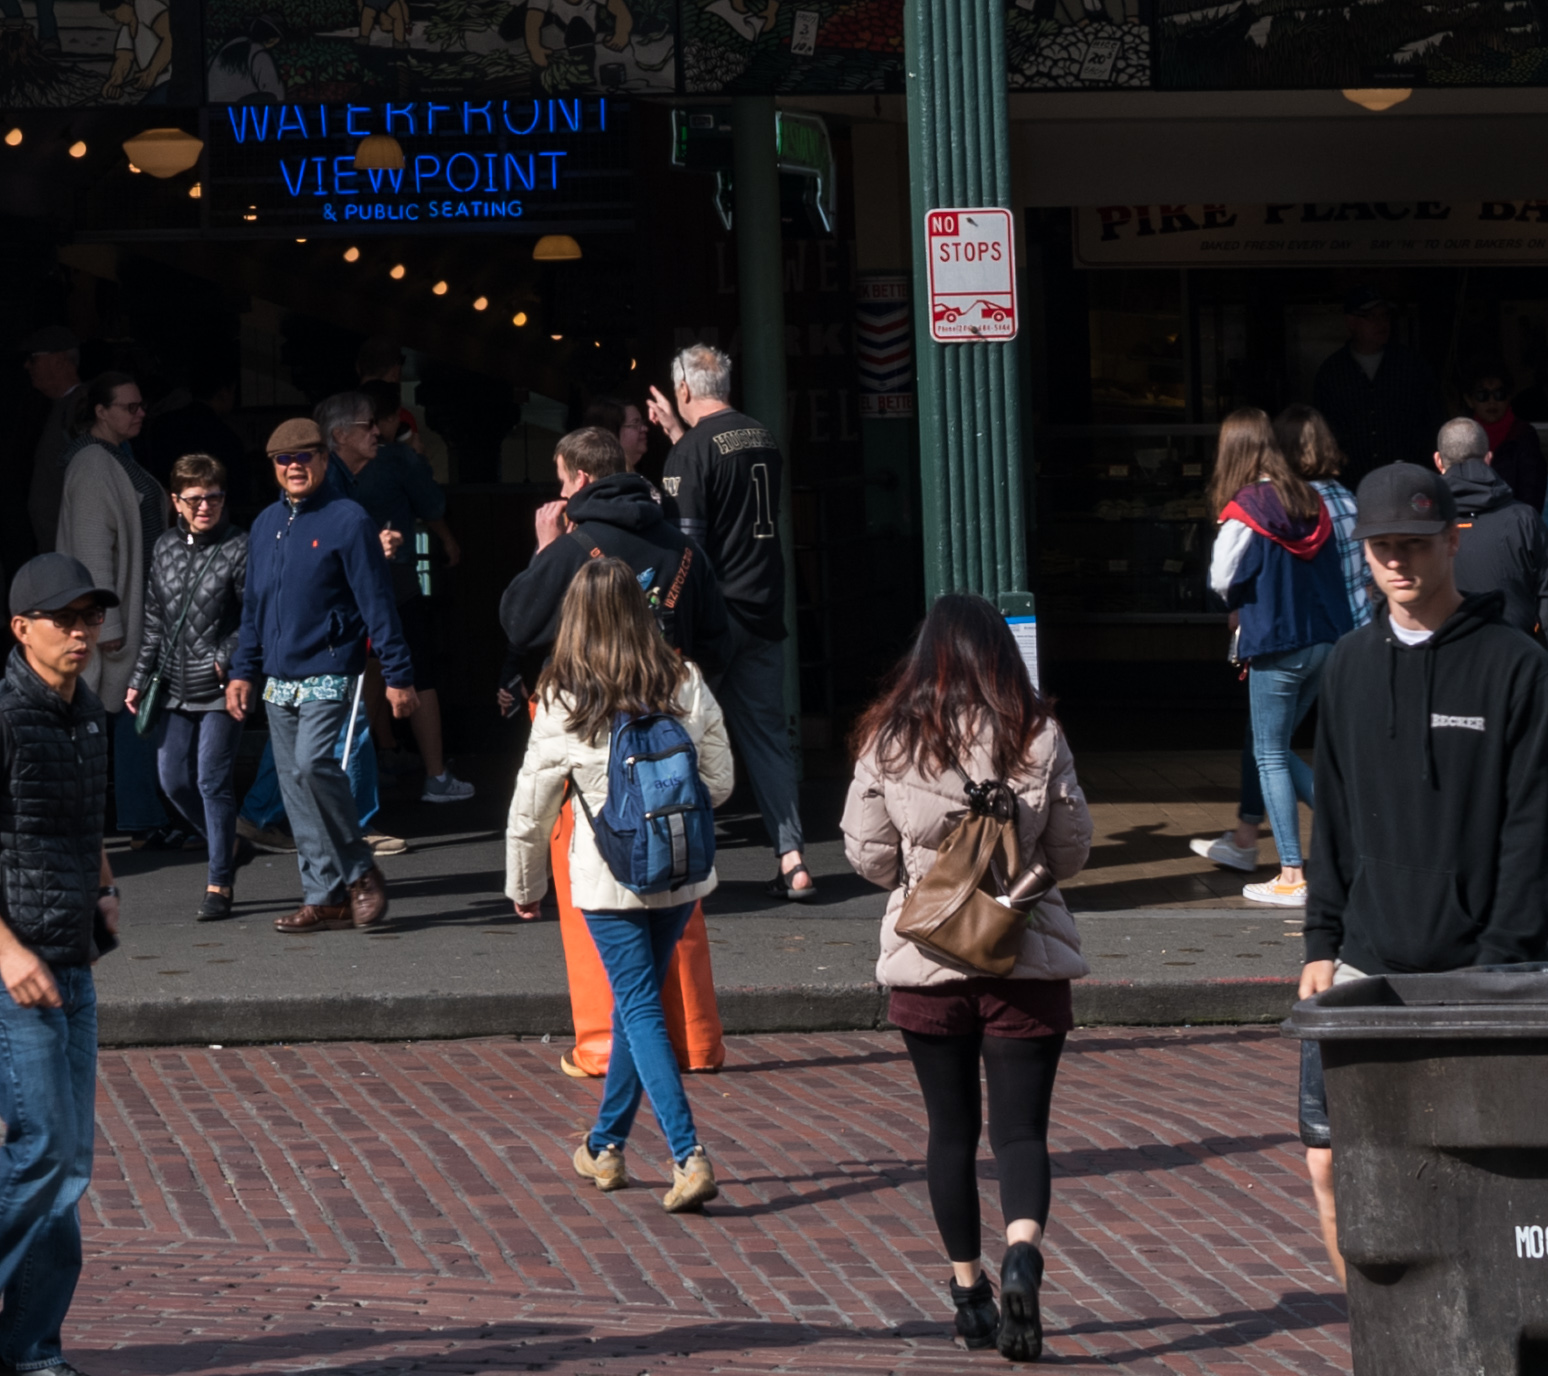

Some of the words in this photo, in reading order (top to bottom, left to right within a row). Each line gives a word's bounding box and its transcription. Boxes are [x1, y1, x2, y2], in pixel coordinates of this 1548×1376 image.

[322, 202, 338, 222] &
[345, 202, 420, 221] PUBLIC
[428, 199, 523, 218] SEATING
[931, 215, 955, 233] NO
[939, 241, 1002, 262] STOPS
[1243, 239, 1285, 250] FRESH
[1287, 239, 1328, 250] EVERY
[1474, 238, 1523, 248] BAKERS
[751, 463, 775, 539] 1
[1431, 713, 1486, 731] BECKER
